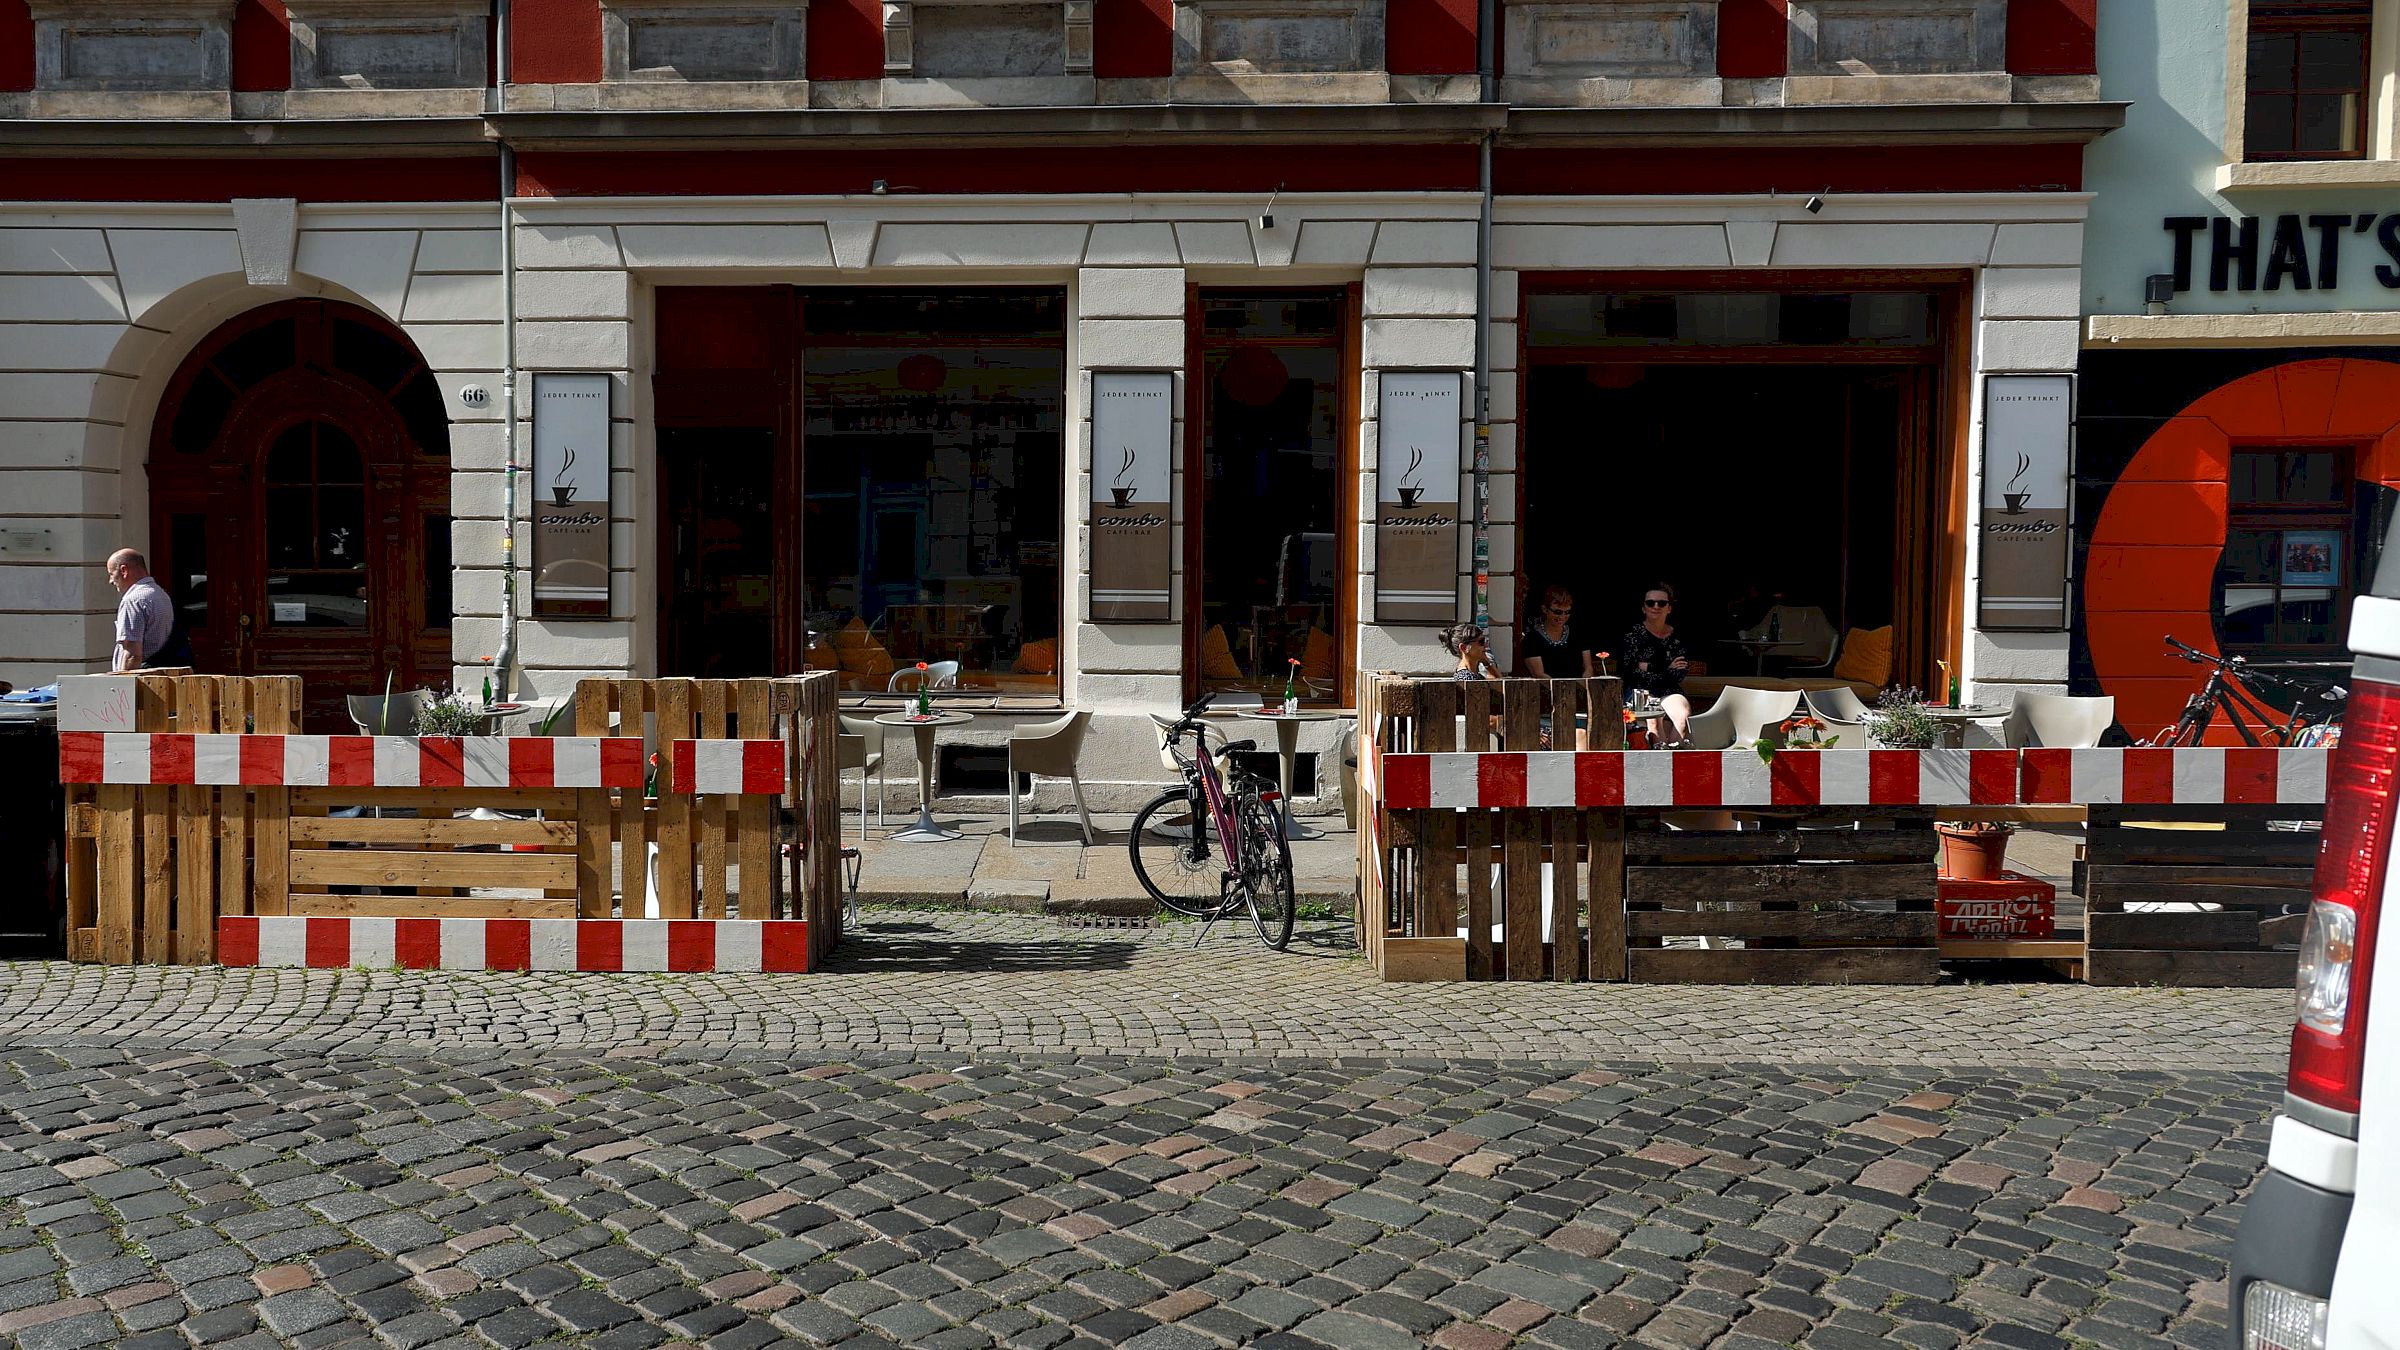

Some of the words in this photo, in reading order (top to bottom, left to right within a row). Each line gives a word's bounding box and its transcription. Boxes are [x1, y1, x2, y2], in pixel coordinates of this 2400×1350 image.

[463, 389, 484, 402] 66
[1420, 391, 1451, 401] TRINKT
[540, 512, 606, 525] combo
[1098, 513, 1166, 527] combo
[1384, 513, 1454, 527] combo
[1988, 520, 2060, 533] combo
